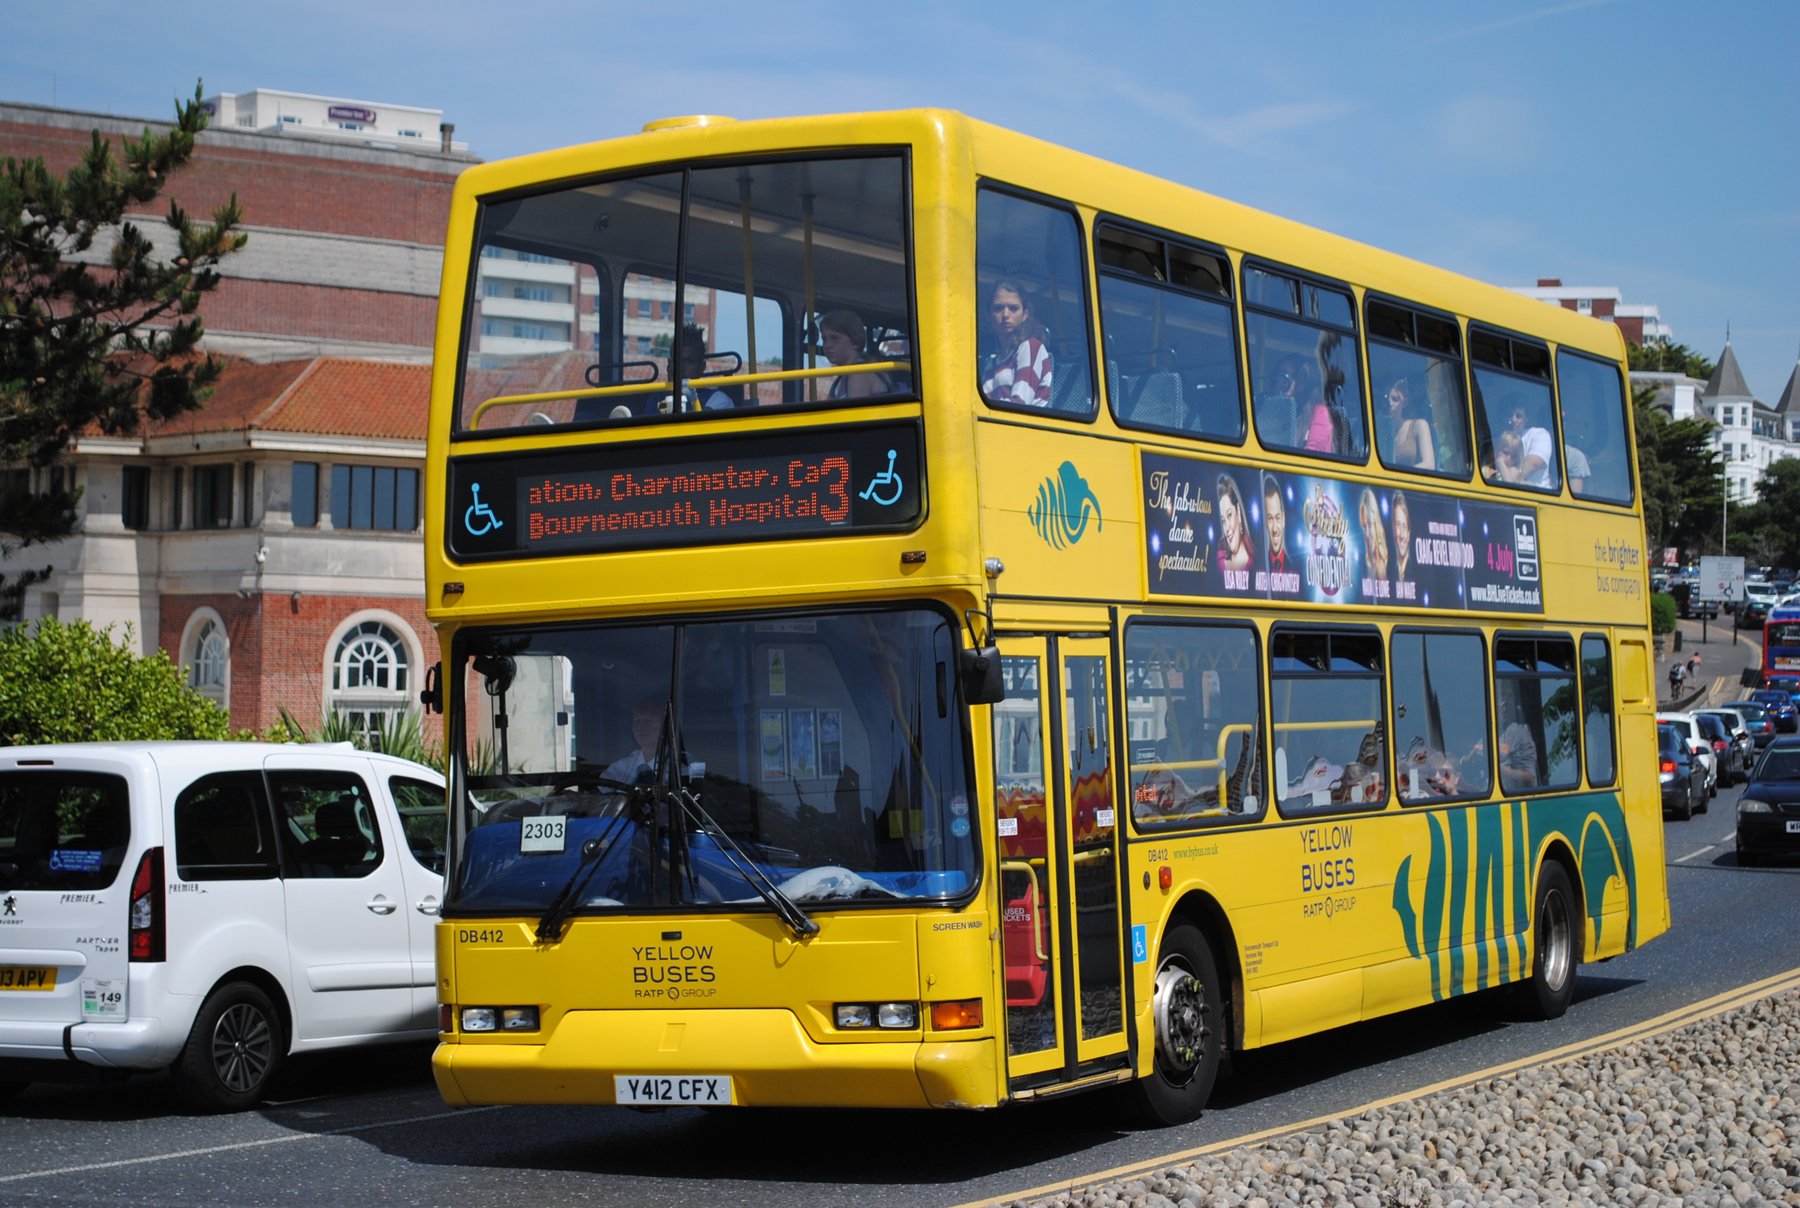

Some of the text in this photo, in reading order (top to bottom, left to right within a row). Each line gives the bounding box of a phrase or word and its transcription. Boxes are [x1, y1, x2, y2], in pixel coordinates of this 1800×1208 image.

[530, 460, 819, 504] ation, Charminster, Ca
[820, 457, 849, 521] 3
[1149, 471, 1172, 509] The
[530, 491, 817, 539] Bournemouth Hospital
[1169, 516, 1194, 543] dance
[1416, 537, 1432, 565] CRAIG
[1487, 543, 1513, 579] 4 July
[1594, 537, 1607, 562] the
[1608, 537, 1639, 571] brighter
[1158, 544, 1209, 582] spectacular!
[1596, 567, 1641, 601] bus company
[524, 823, 564, 839] 2303
[1300, 825, 1352, 853] YELLOW
[1148, 848, 1168, 862] DB412
[1302, 858, 1355, 892] BUSES
[60, 894, 96, 905] PREMIER
[169, 884, 199, 894] PREMIER
[1004, 907, 1025, 915] USED
[1004, 913, 1031, 922] ICKETS
[1303, 896, 1356, 918] RATP GROUP
[460, 929, 504, 943] DB412
[932, 921, 967, 931] SCREEN
[632, 945, 713, 961] YELLOW
[0, 970, 48, 988] 13 APV
[633, 965, 716, 983] BUSES
[100, 992, 122, 1003] 149
[634, 988, 717, 998] RATP GROUP
[628, 1079, 718, 1100] Y412 CFX
